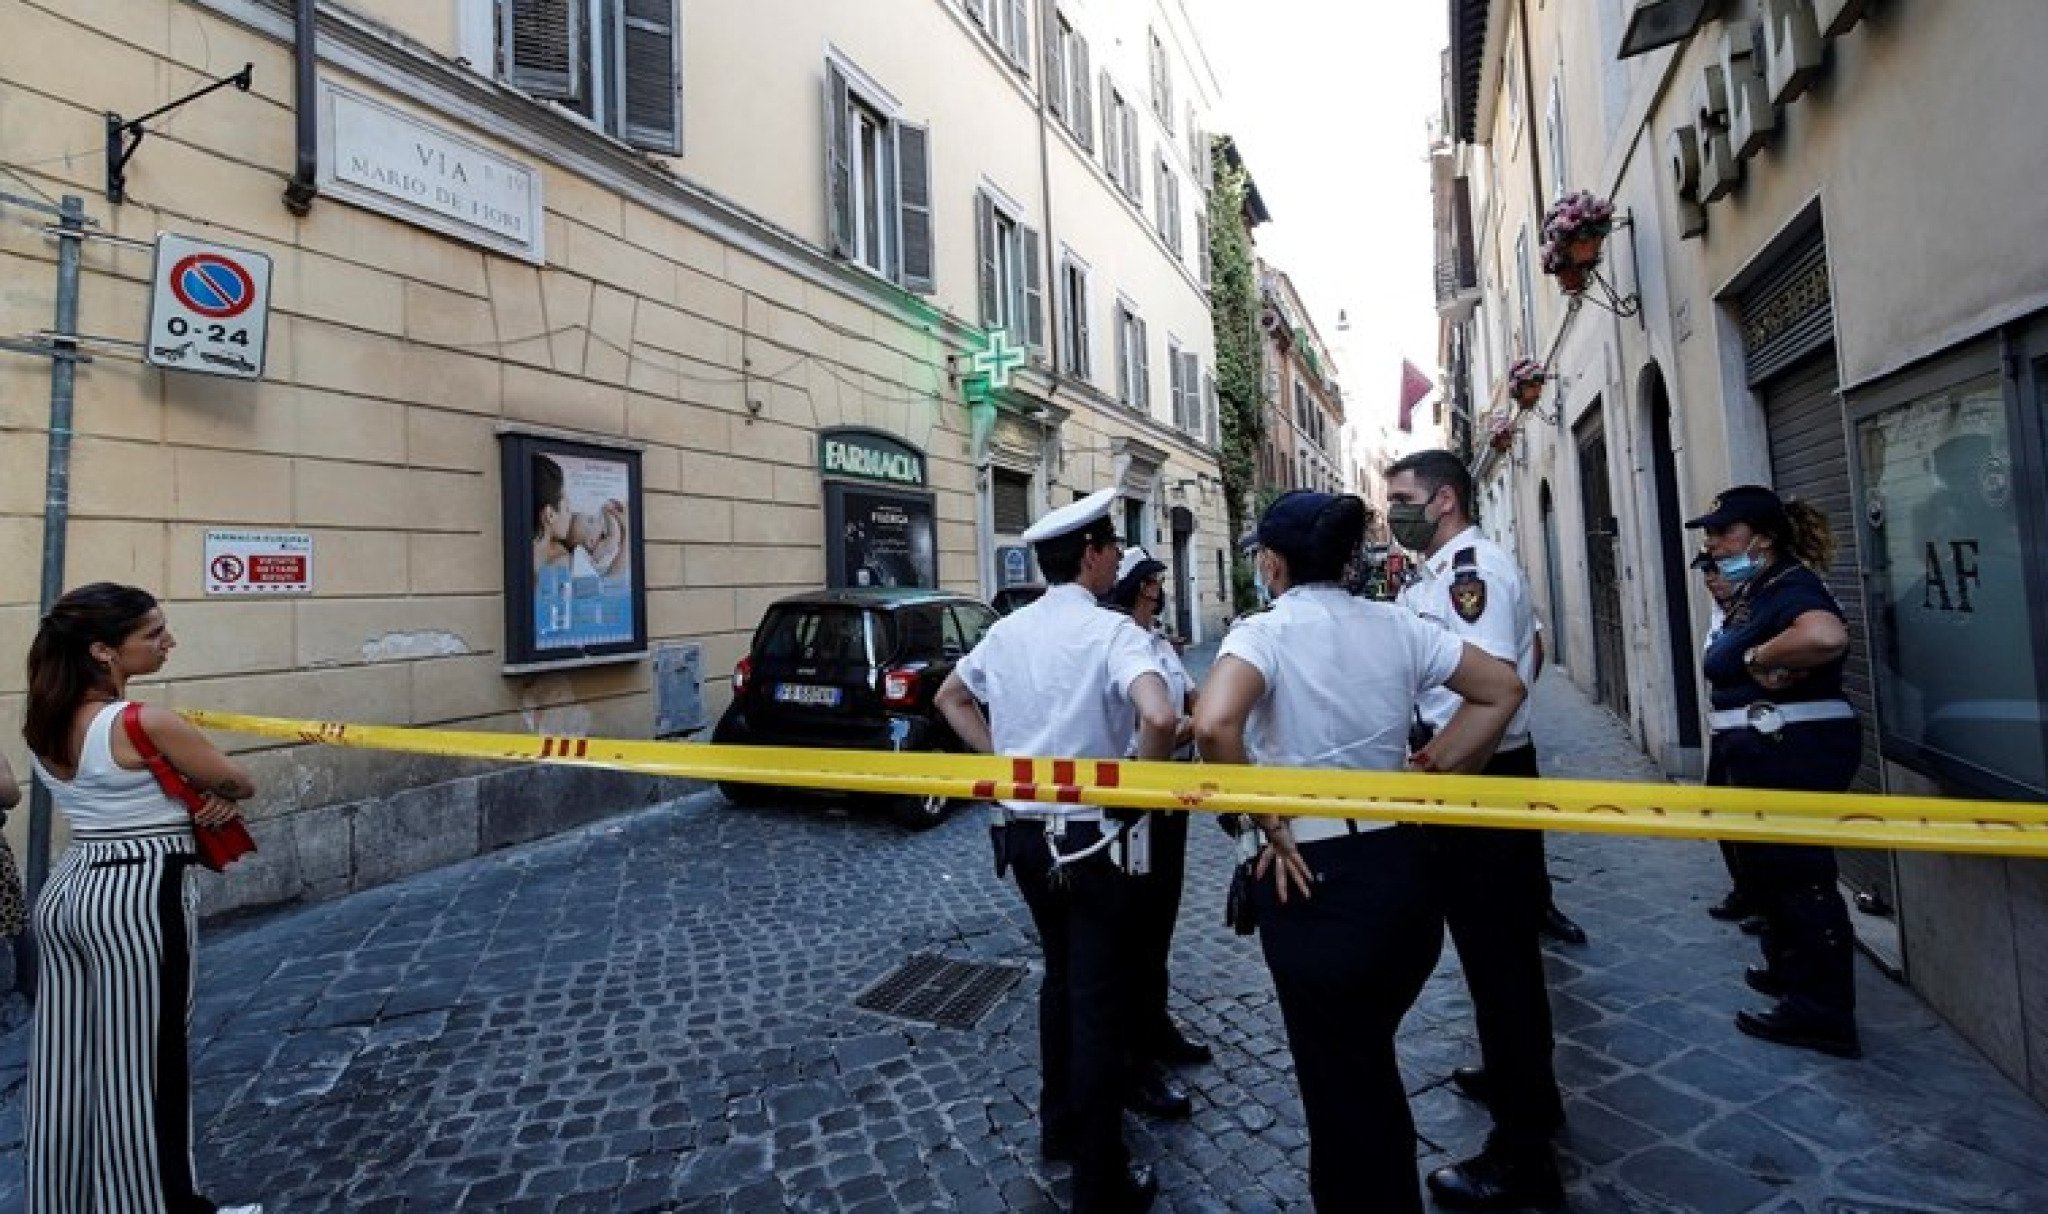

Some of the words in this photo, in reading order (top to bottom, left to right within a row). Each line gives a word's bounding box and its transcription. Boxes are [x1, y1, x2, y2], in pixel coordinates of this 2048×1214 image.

[416, 142, 468, 183] VIA
[351, 155, 427, 197] MARIO
[471, 199, 522, 232] FIORI
[825, 439, 922, 484] FARMACIA
[1923, 538, 1981, 613] AF
